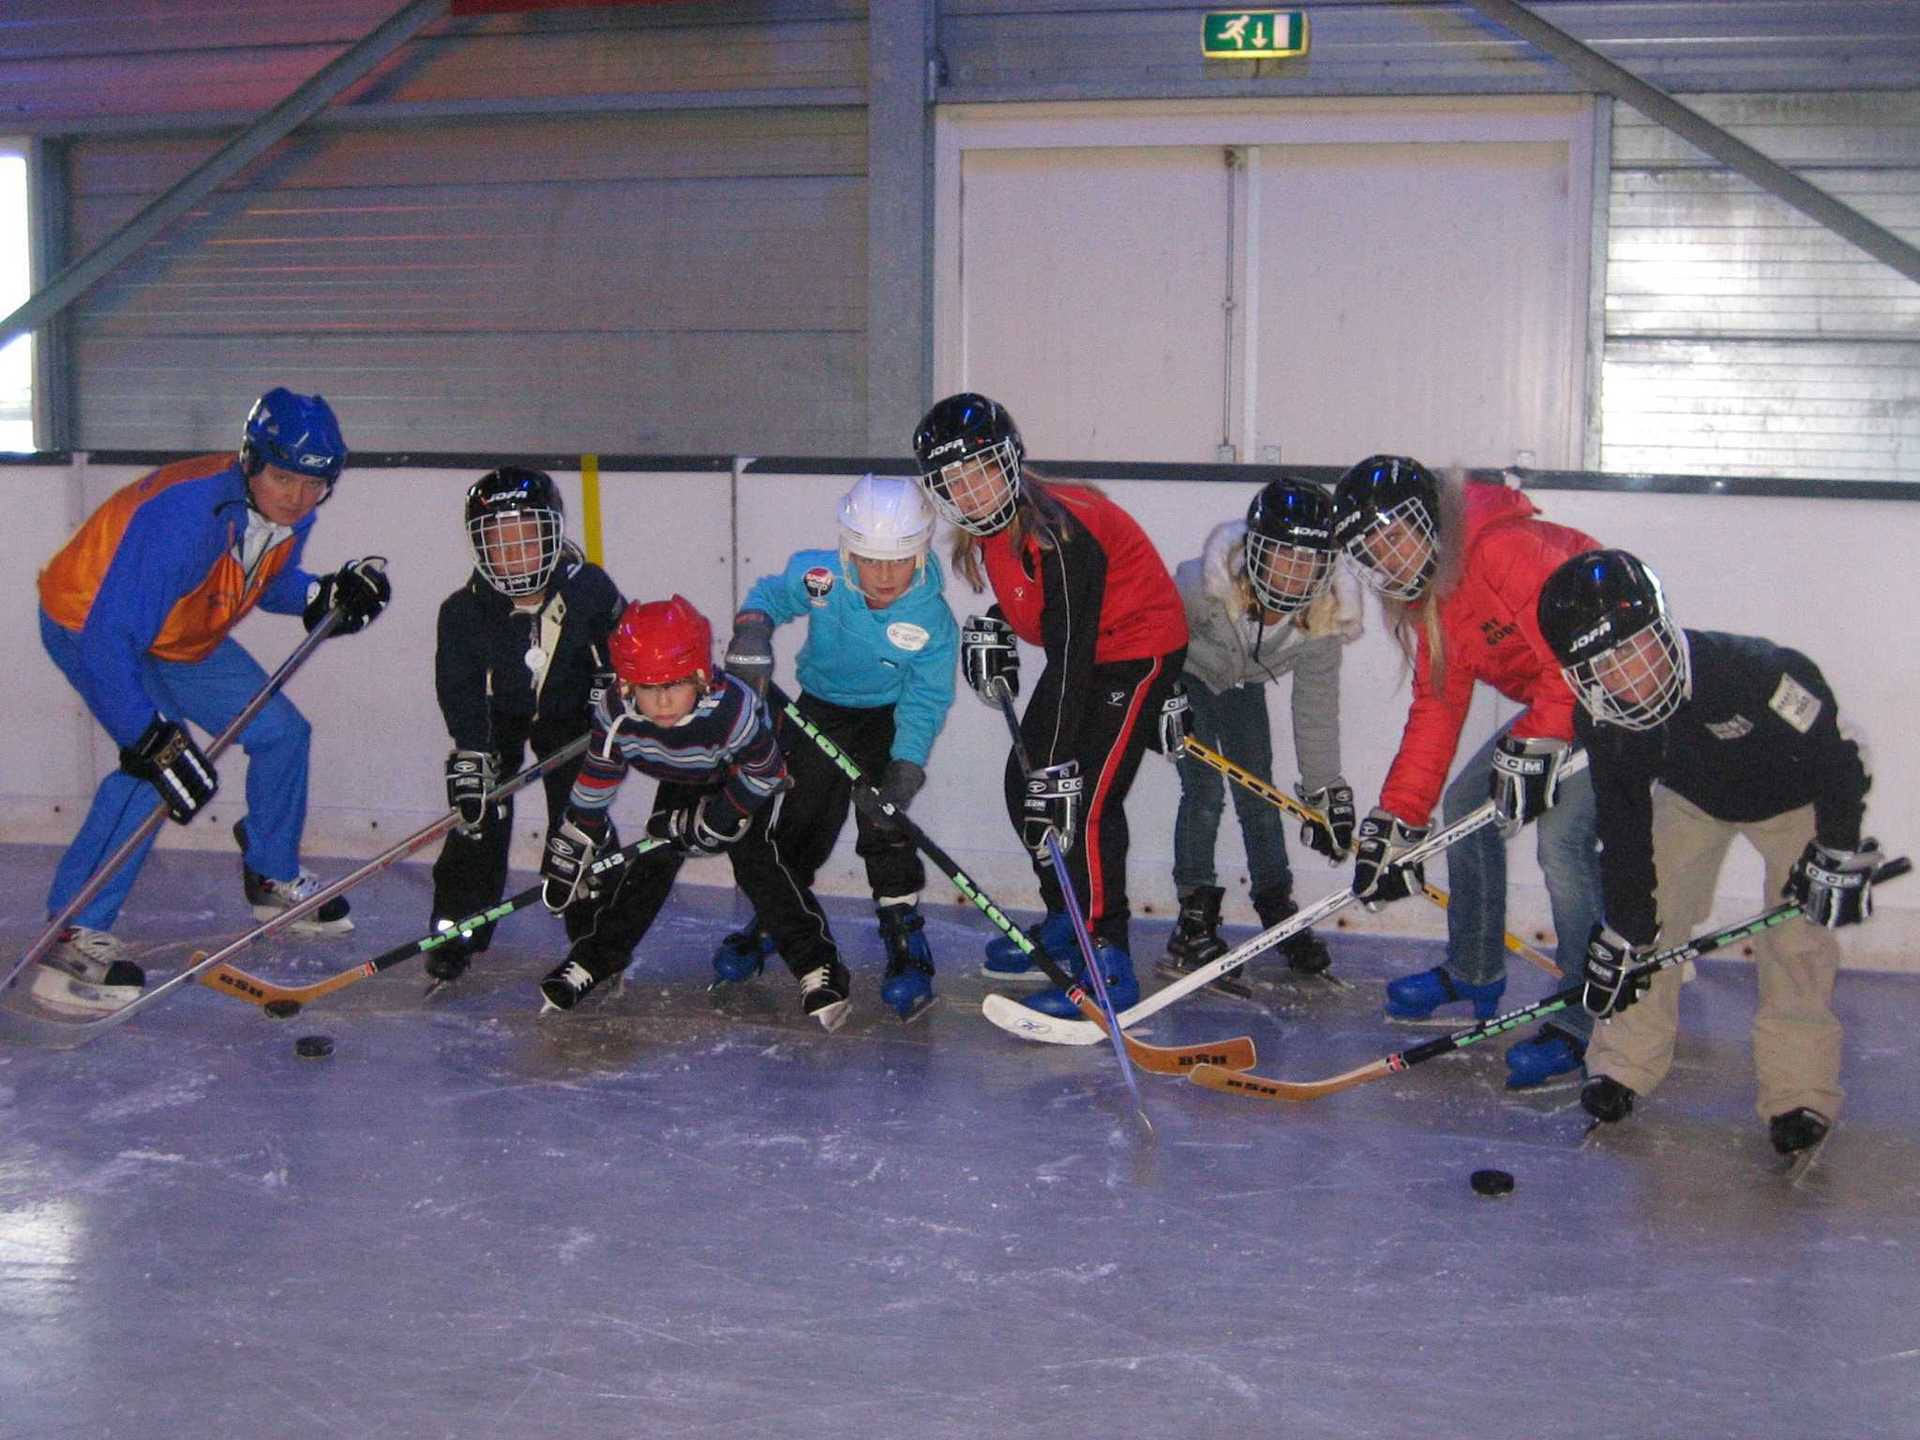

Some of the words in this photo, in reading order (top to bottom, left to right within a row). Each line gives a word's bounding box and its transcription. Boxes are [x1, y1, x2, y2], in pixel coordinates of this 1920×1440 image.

[926, 438, 964, 459] JOFA
[486, 491, 528, 503] JOFA
[1289, 526, 1329, 538] JOFA
[1569, 620, 1612, 652] JOFA
[1494, 751, 1545, 776] CCM
[590, 852, 625, 874] 213
[1807, 865, 1863, 888] CCM
[1716, 904, 1806, 946] LIO
